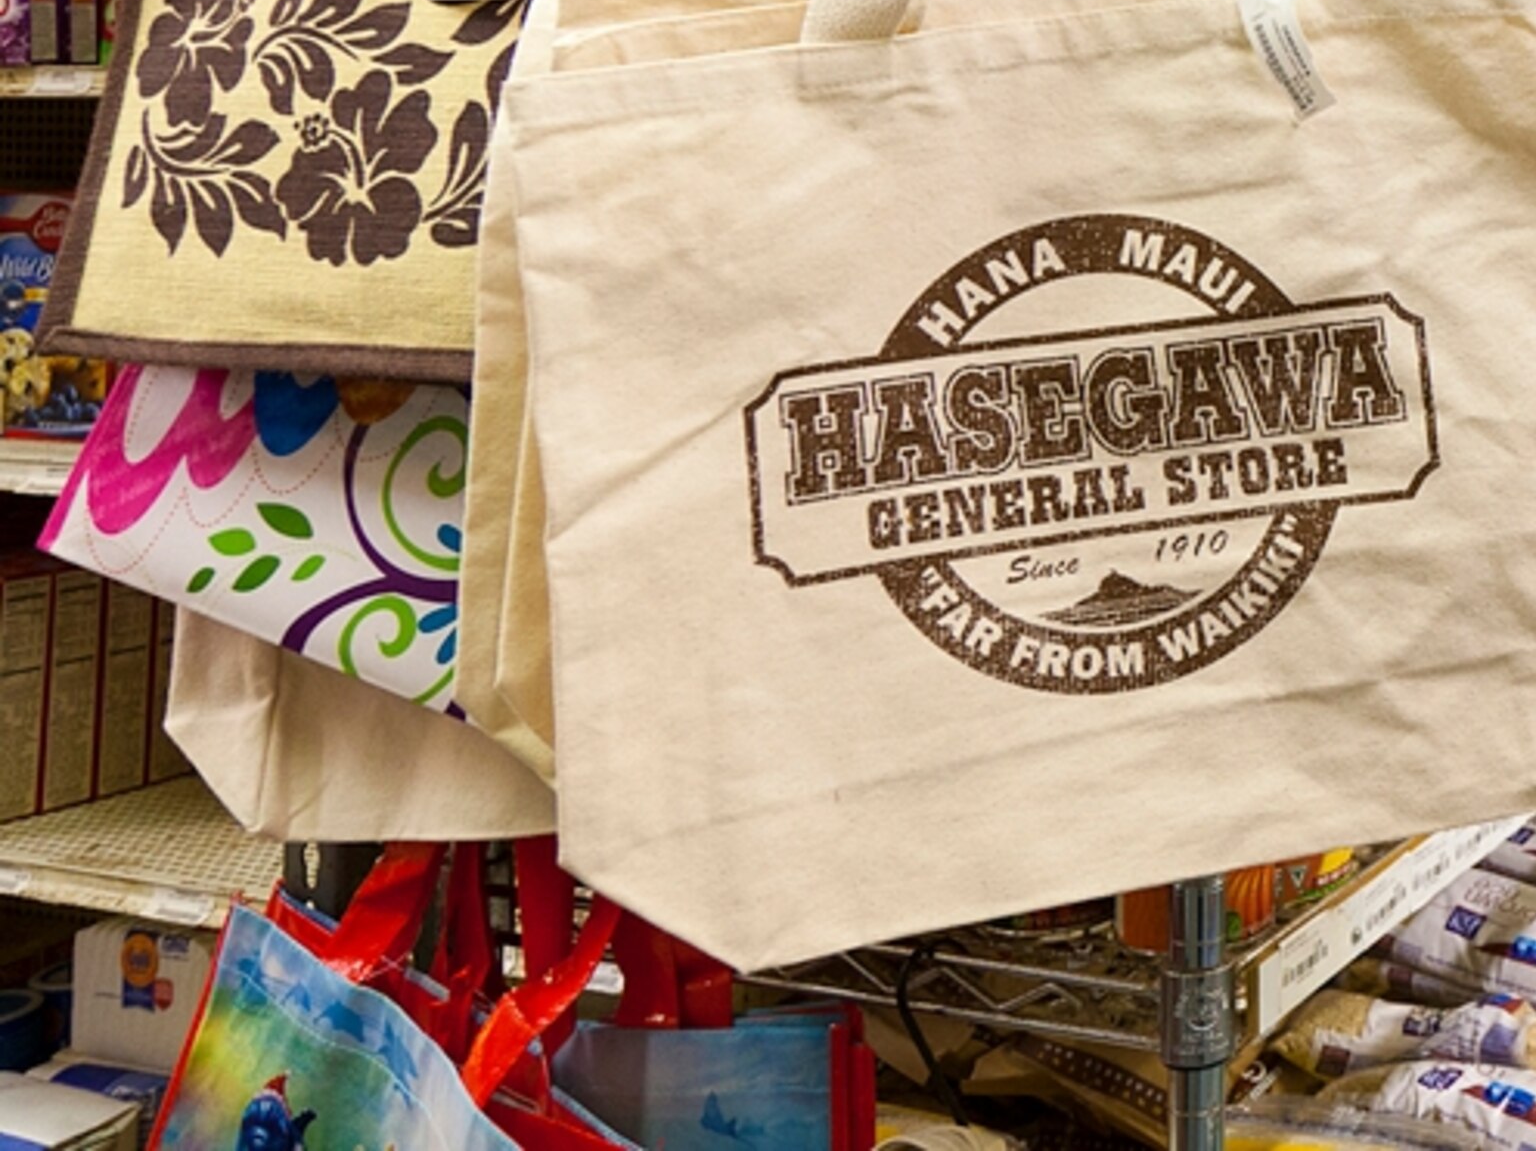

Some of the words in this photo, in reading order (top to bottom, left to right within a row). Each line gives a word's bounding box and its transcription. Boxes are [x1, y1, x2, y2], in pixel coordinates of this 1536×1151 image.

[917, 237, 1066, 346] HANA
[1119, 228, 1259, 314] MAUI
[780, 317, 1407, 505] HASEGAWA
[867, 463, 1145, 549] GENERAL
[1164, 437, 1348, 504] STORE
[918, 565, 1008, 659] "FAR
[1010, 640, 1146, 681] FROM
[1157, 513, 1306, 664] WAIKIKI"
[1005, 554, 1080, 586] Since
[1153, 529, 1231, 563] 1910
